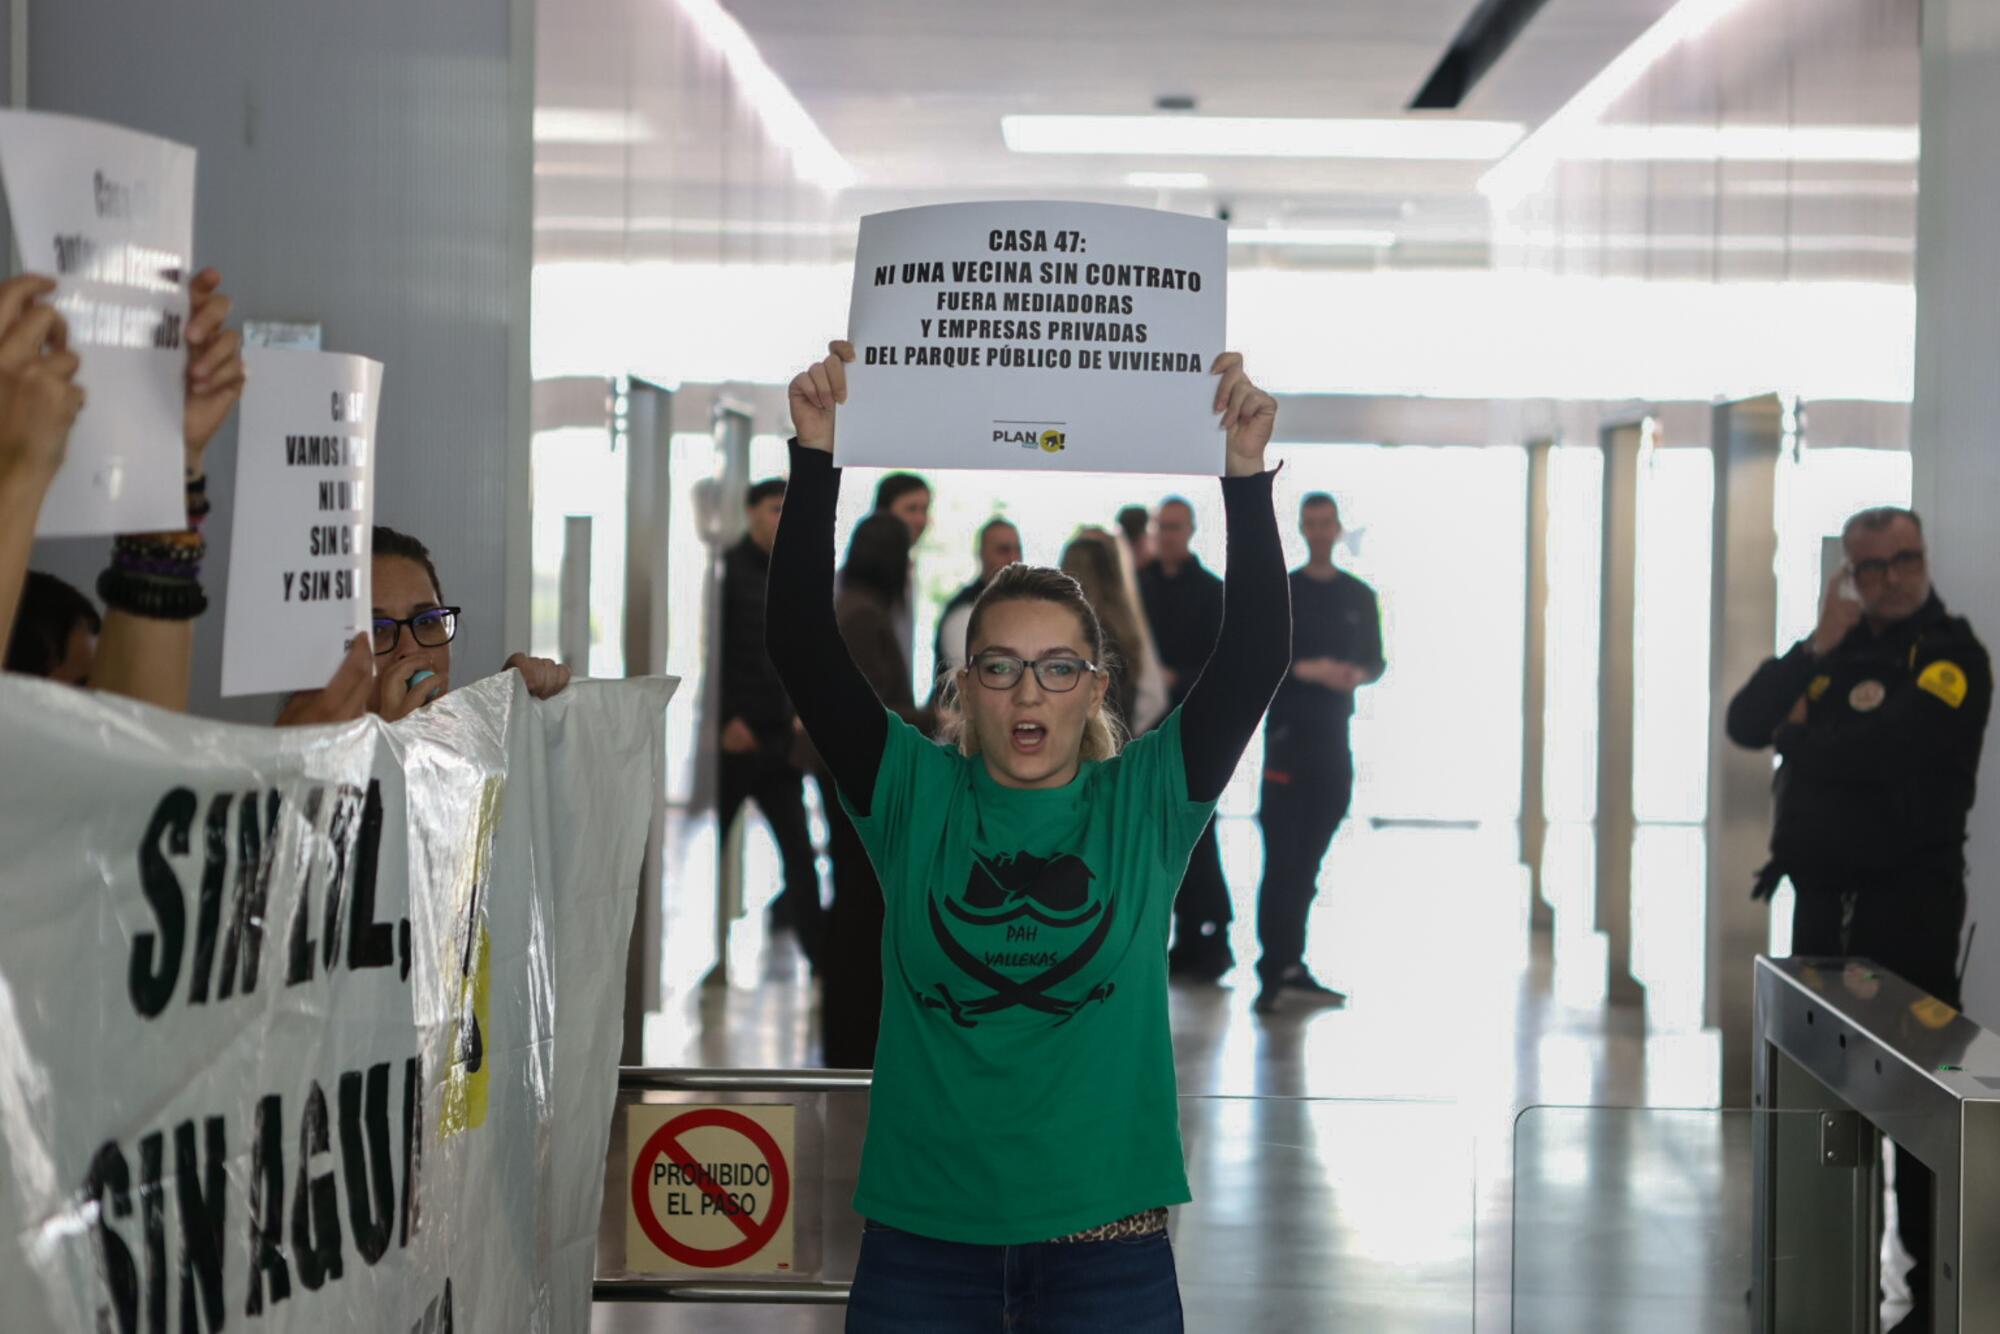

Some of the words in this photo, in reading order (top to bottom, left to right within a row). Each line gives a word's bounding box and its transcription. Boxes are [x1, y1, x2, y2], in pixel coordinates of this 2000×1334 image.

[989, 230, 1047, 252] CASA
[1054, 231, 1086, 253] 47:
[874, 265, 896, 286] NI
[902, 262, 945, 284] UNA
[952, 261, 1032, 284] VECINA
[1040, 262, 1078, 285] SIN
[1086, 263, 1202, 293] CONTRATO
[936, 291, 997, 311] FUERA
[1003, 293, 1133, 315] MEDIADORAS
[920, 319, 932, 338] Y
[938, 319, 1041, 341] EMPRESAS
[1048, 321, 1148, 343] PRIVADAS
[865, 346, 898, 366] DEL
[905, 347, 980, 368] PARQUE
[987, 344, 1072, 369] PÚBLICO
[1079, 349, 1102, 370] DE
[1109, 350, 1202, 373] VIVIENDA
[993, 430, 1037, 443] PLAN
[285, 435, 339, 467] VAMOS
[319, 481, 335, 511] NI
[310, 525, 338, 557] SIN
[283, 571, 295, 602] Y
[299, 571, 331, 602] SIN
[128, 785, 282, 1020] SIN
[1007, 926, 1037, 942] PAH
[986, 952, 1057, 967] VALLEKAS
[653, 1163, 770, 1186] PROHIBIDO
[667, 1192, 693, 1215] EL
[701, 1192, 756, 1216] PASO
